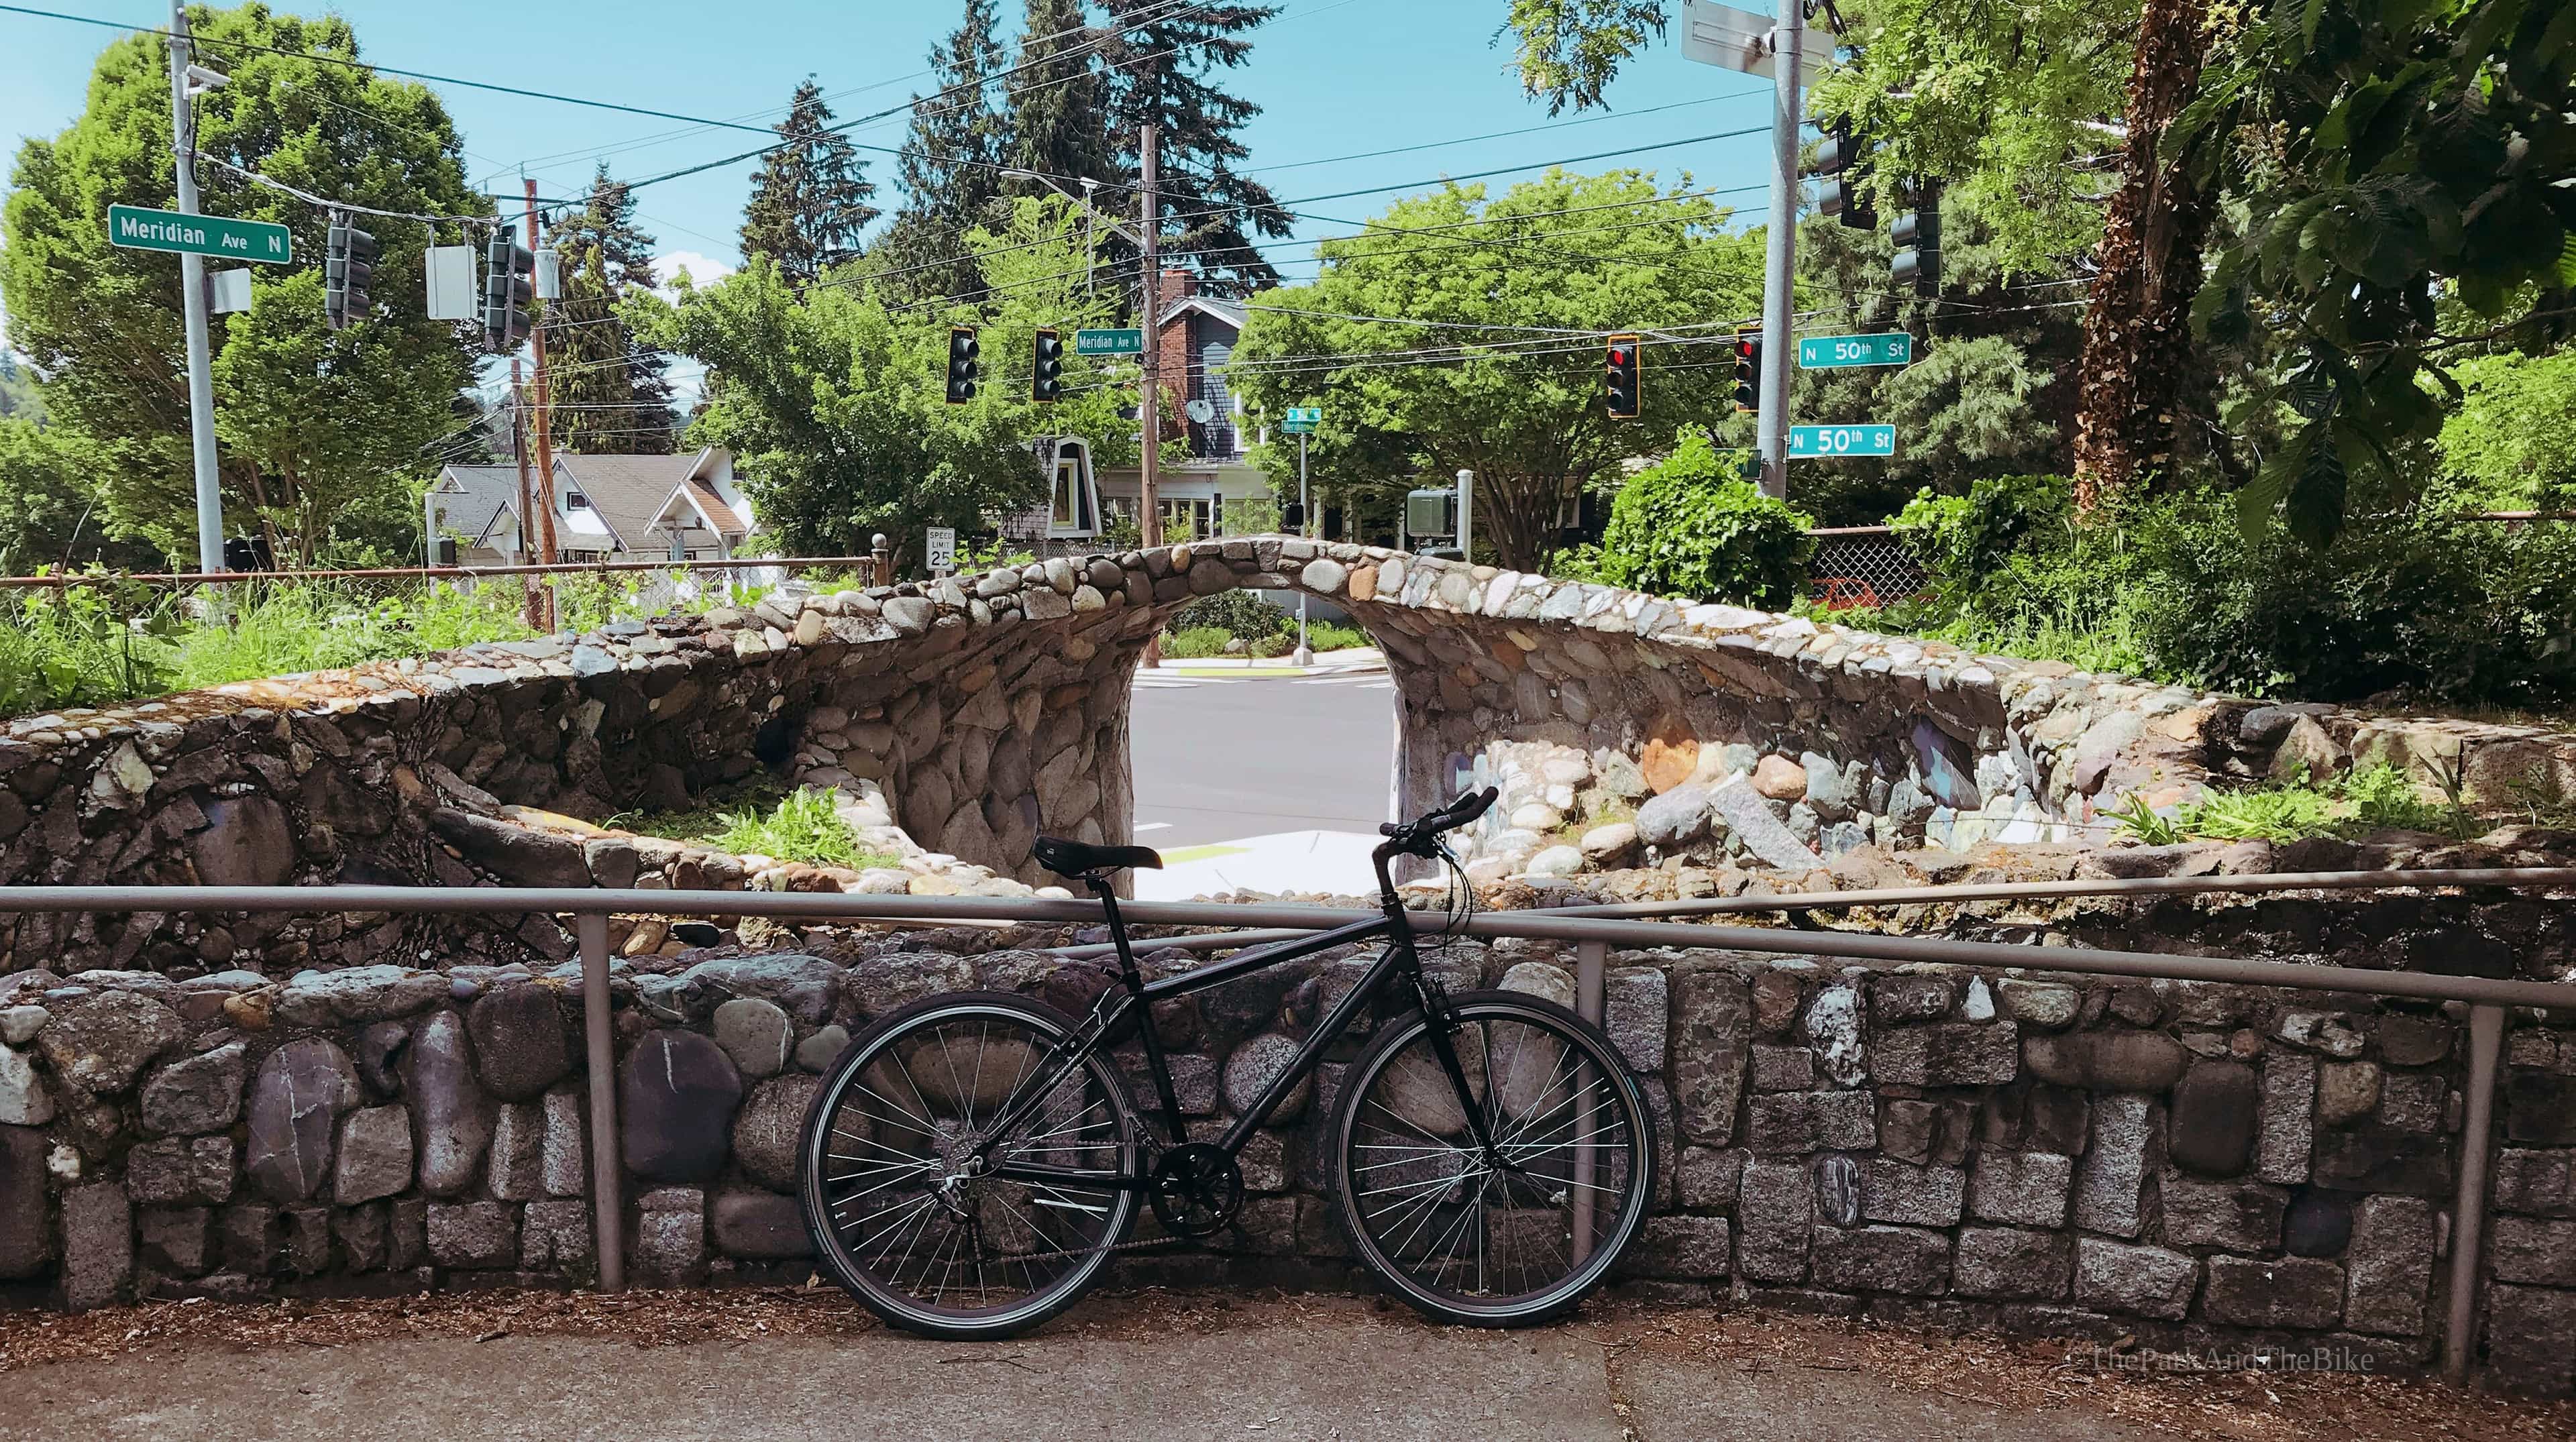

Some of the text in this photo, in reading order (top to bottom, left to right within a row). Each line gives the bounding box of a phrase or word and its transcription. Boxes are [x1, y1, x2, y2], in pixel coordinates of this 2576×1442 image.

[120, 216, 281, 254] Meridian Ave N
[1079, 335, 1139, 349] Meridian Ave N
[1806, 342, 1904, 361] N 50th St
[1793, 429, 1890, 452] N 50th St
[929, 531, 953, 539] SPEED
[931, 551, 950, 566] 25
